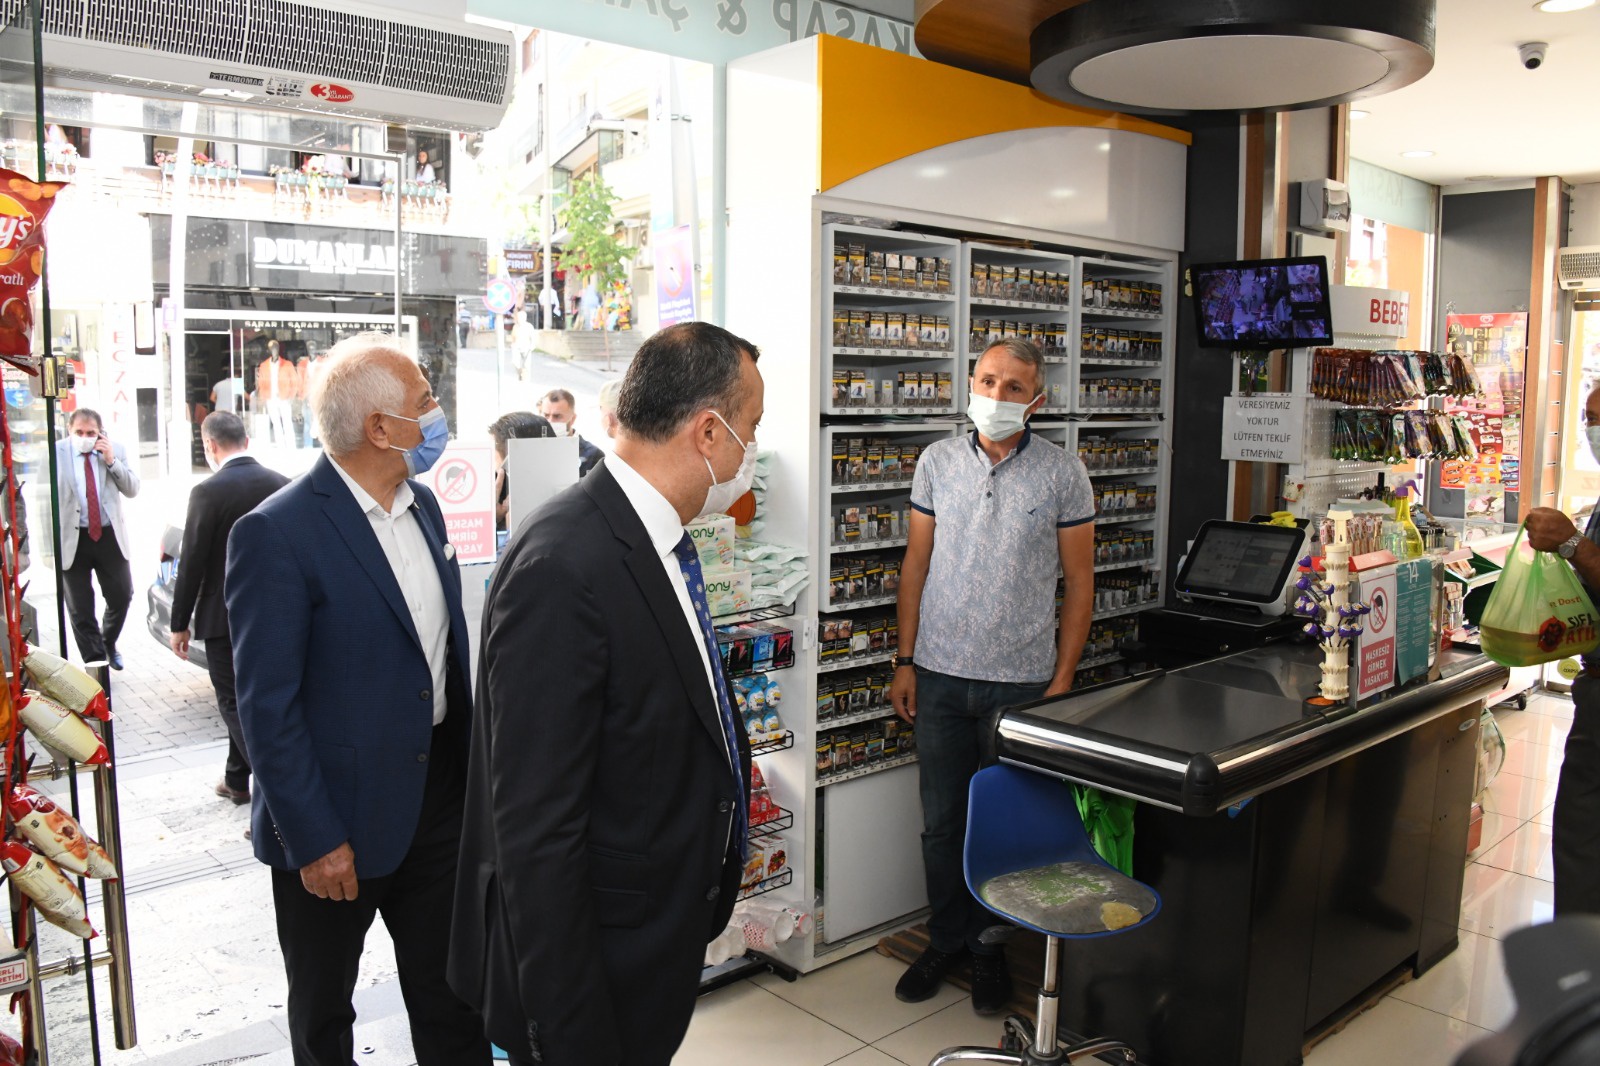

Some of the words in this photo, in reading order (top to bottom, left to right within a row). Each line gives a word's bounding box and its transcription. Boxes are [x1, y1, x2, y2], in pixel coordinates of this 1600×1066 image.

[318, 83, 331, 100] 3
[506, 260, 534, 270] FIRINI
[1238, 400, 1291, 410] VERESİYEMİZ
[1246, 416, 1279, 426] YOKTUR
[1233, 431, 1263, 442] LÜTFEN
[1265, 433, 1292, 443] TEKLİF
[1240, 448, 1284, 460] ETMEYİNİZ
[1365, 643, 1390, 662] MASKESİZ
[1367, 658, 1387, 674] GİRMEK
[1364, 670, 1389, 687] YASAKTIR
